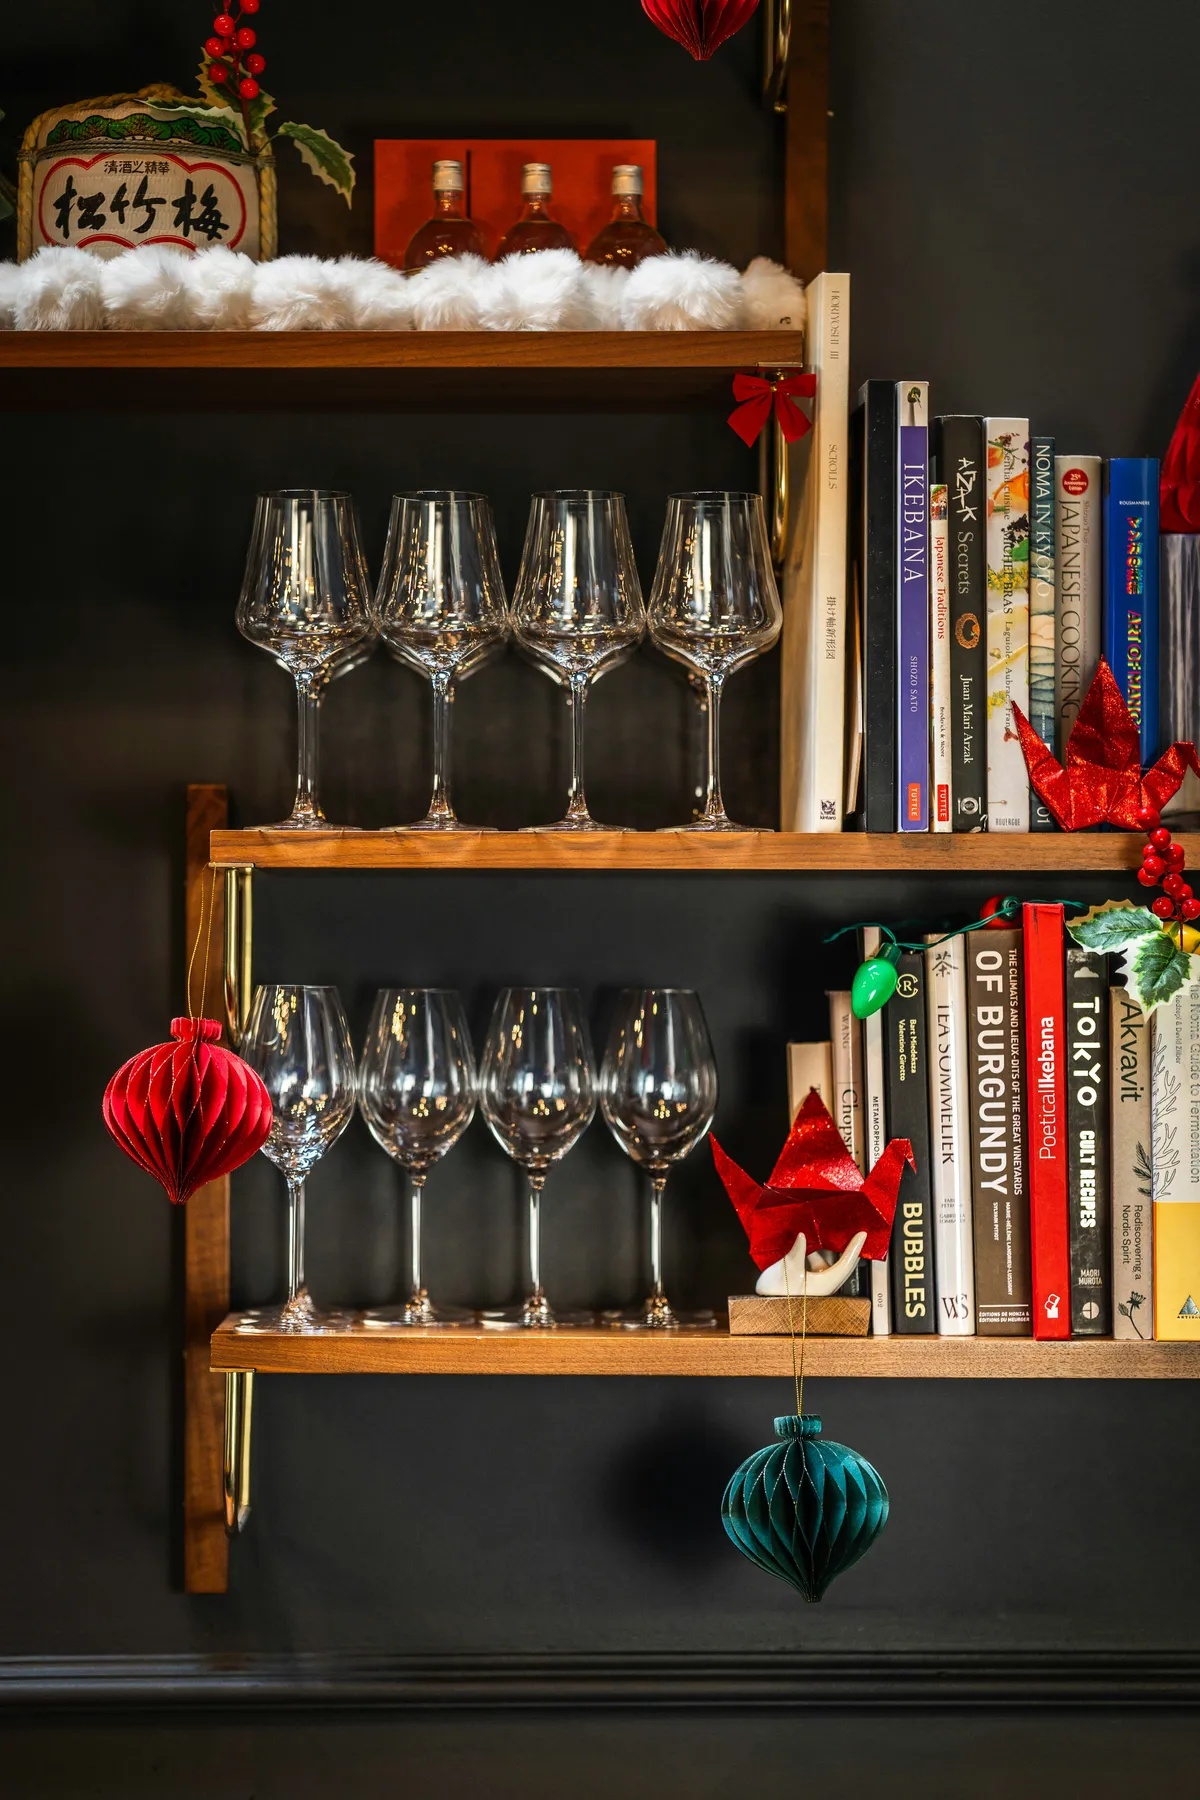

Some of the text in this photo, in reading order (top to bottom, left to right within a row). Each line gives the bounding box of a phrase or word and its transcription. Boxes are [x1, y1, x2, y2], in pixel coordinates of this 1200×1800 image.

[52, 174, 230, 240] 松竹梅
[830, 290, 841, 345] HORIYOSHI
[828, 444, 838, 490] SCROLLS
[903, 463, 926, 584] IKEBANA
[1036, 445, 1050, 597] NOMA IN KYOTO
[934, 536, 948, 640] Japanese Traditions
[957, 530, 973, 594] Secrets
[1003, 581, 1013, 614] BRAS
[1059, 500, 1081, 719] JAPANESE COOKING
[1003, 621, 1013, 658] Laguiole
[909, 655, 918, 713] SHOZO SATO
[1003, 668, 1013, 698] Aubrac
[1127, 610, 1141, 735] ART OF MANG
[939, 706, 947, 733] Broderick
[960, 674, 974, 765] Juan Mari Arzak
[939, 789, 947, 818] TUTTLE
[842, 1014, 850, 1049] WANG
[898, 1019, 907, 1081] Valentino Girotto
[1119, 1000, 1144, 1103] Akvavit
[1190, 1004, 1200, 1040] Noma
[938, 1001, 955, 1164] TEA SOMMELIER
[976, 949, 1007, 1196] OF BURGUNDY
[1009, 948, 1022, 1196] THE CLIMATS AND LIEUX-DITS OF THE GREAT VINEYARDS
[1190, 1044, 1200, 1080] Guide
[1190, 1083, 1200, 1096] to
[1079, 1130, 1096, 1167] CULT
[1190, 1099, 1200, 1184] Fermentation
[1079, 1169, 1097, 1228] RECIPES
[903, 1202, 926, 1318] BUBBLES
[1120, 1205, 1132, 1264] Nordic Spirit
[1131, 1204, 1143, 1273] Rediscovering
[1078, 1277, 1102, 1285] MUROTA
[1080, 1269, 1100, 1277] MAORI
